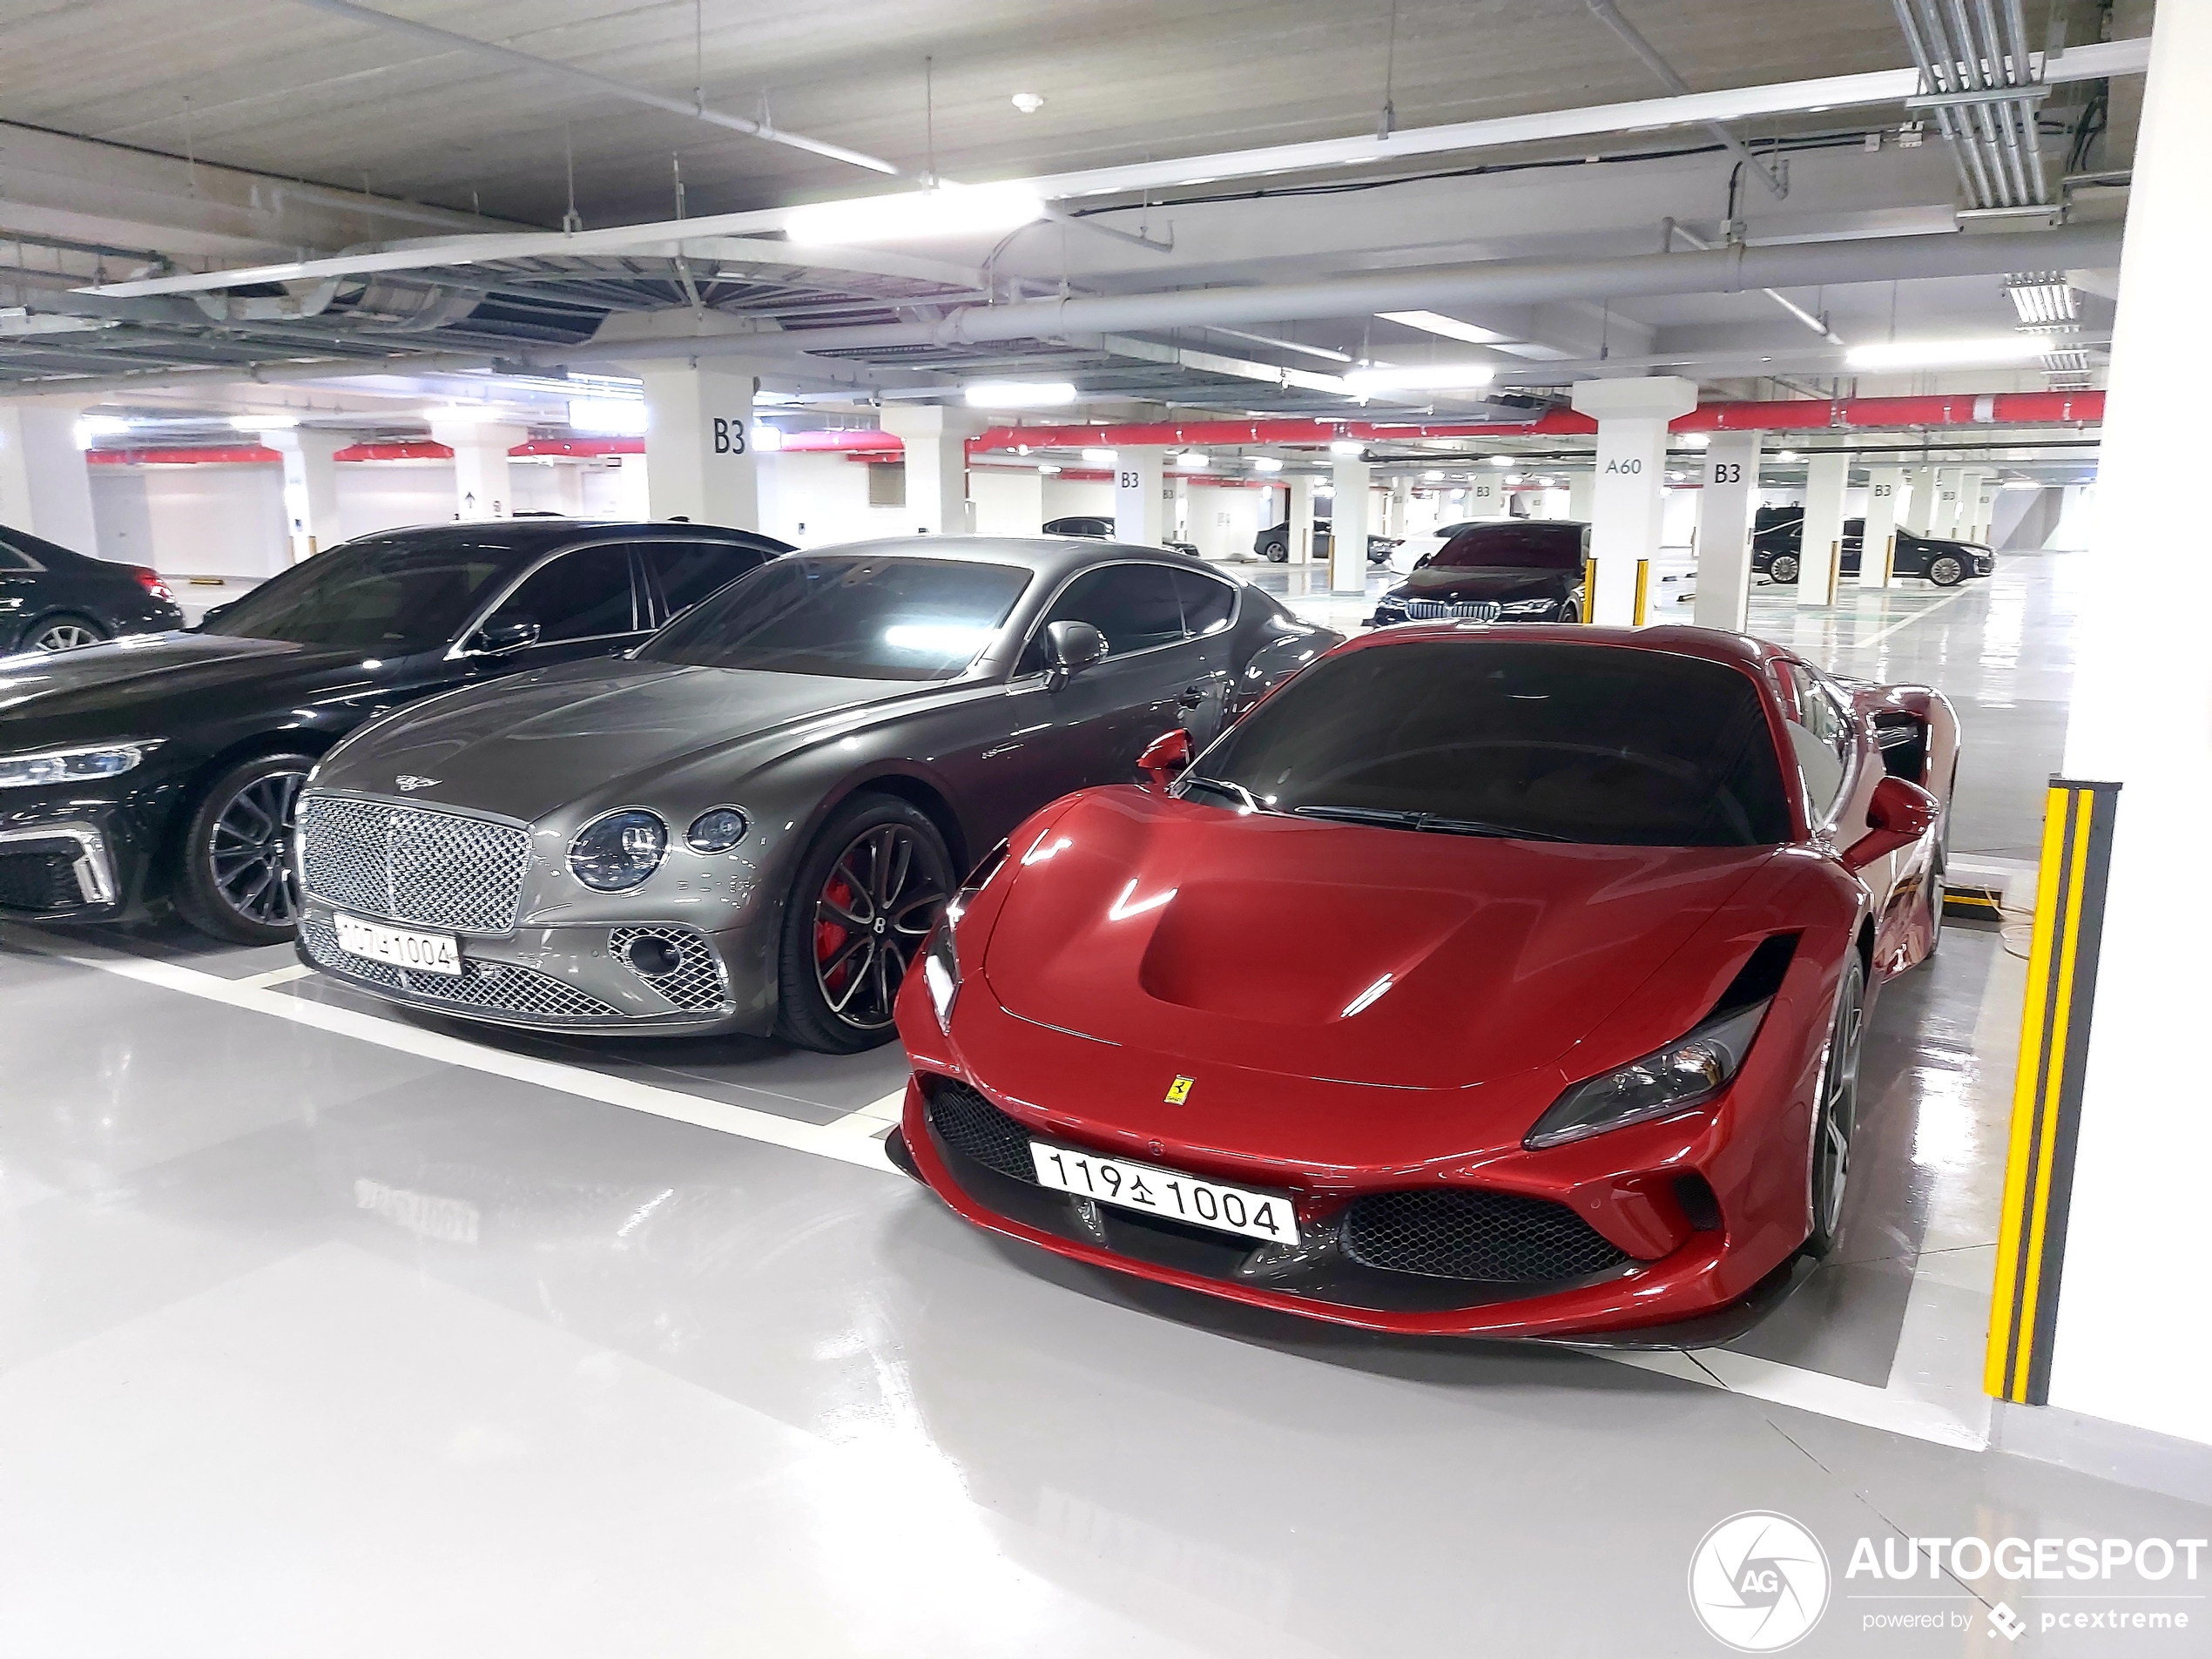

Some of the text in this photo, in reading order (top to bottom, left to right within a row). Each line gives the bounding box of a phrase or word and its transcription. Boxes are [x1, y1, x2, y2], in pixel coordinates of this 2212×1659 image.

[713, 417, 745, 455] B3
[1605, 459, 1642, 475] A60
[1715, 463, 1741, 483] B3
[1122, 472, 1139, 488] B3
[1477, 486, 1490, 496] B3
[1875, 484, 1891, 496] B3
